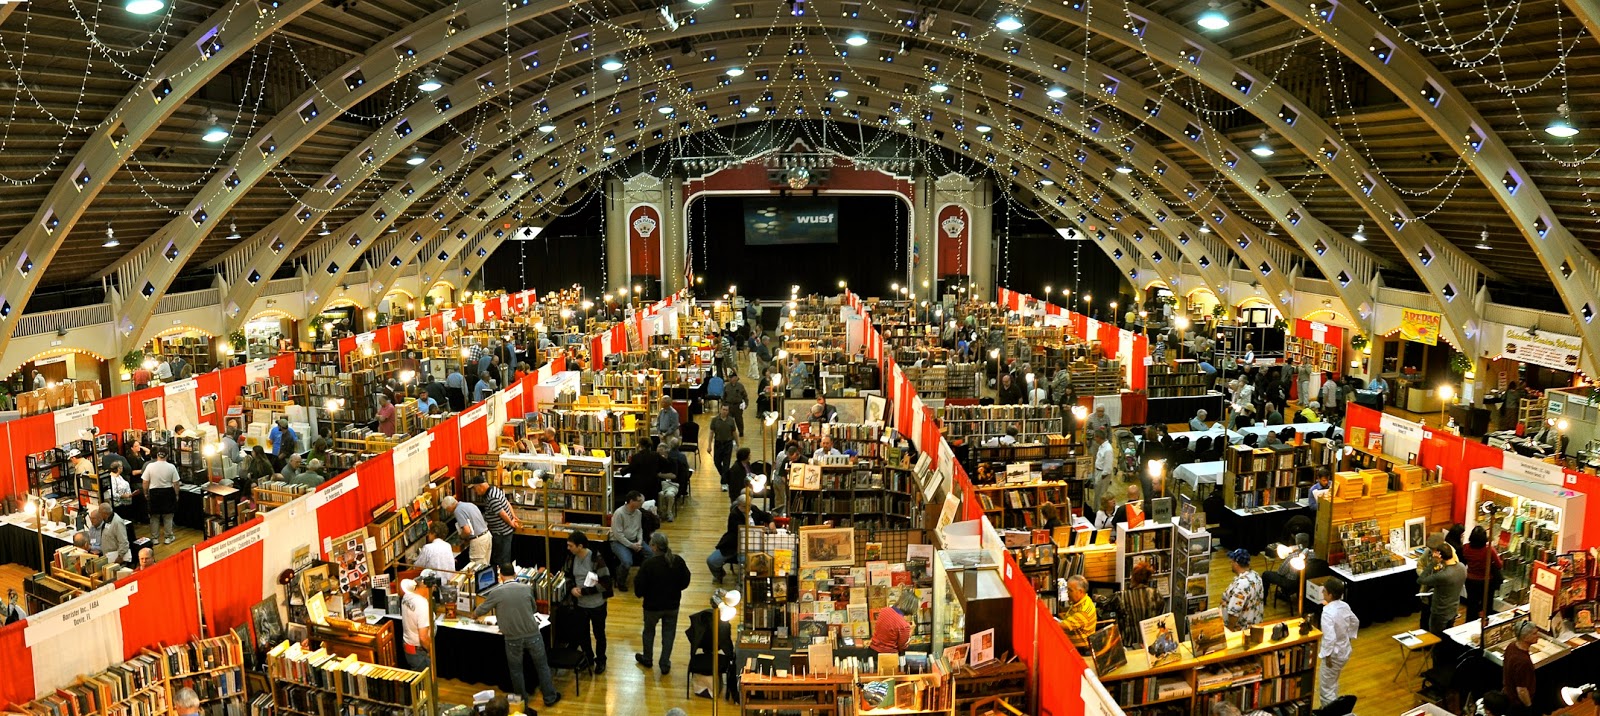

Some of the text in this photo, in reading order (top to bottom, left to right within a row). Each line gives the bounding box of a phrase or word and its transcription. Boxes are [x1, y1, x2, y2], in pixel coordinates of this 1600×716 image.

[797, 213, 834, 224] wusf
[1404, 311, 1440, 327] AREPAS
[62, 609, 80, 622] Barrister
[73, 617, 85, 627] Davie,
